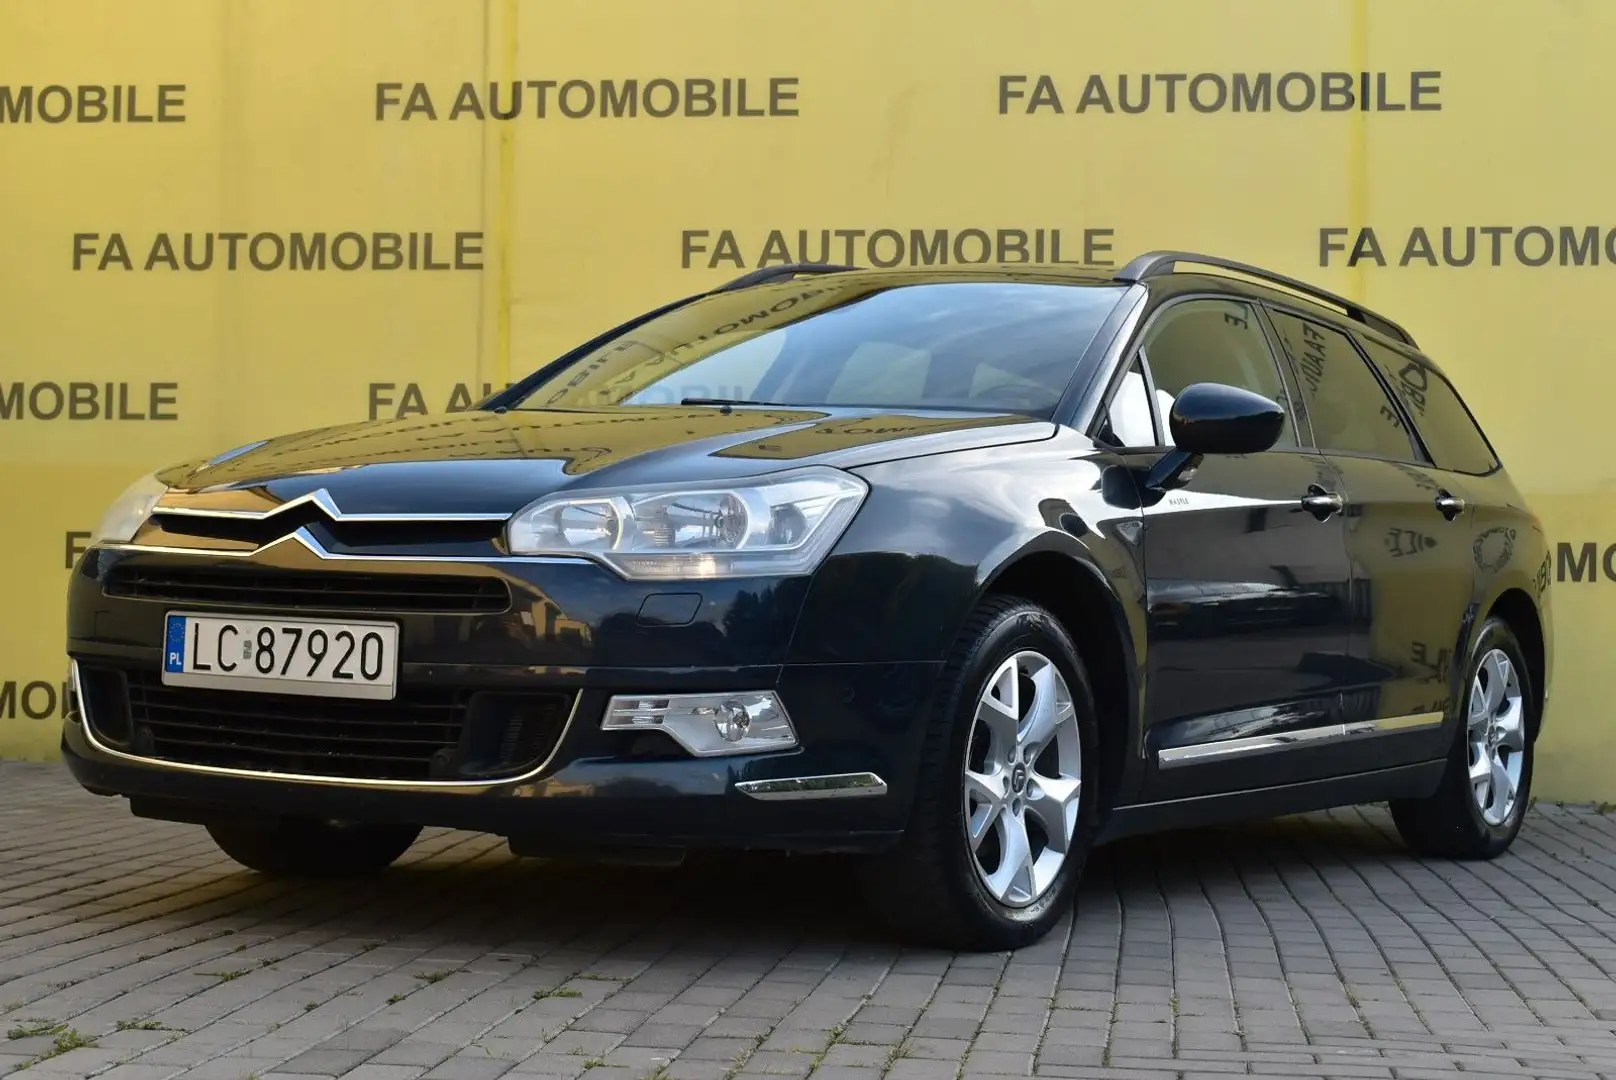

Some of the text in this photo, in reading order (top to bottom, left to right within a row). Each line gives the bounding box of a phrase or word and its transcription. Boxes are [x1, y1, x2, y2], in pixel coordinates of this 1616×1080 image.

[0, 85, 185, 123] MOBILE
[376, 78, 798, 120] FA AUTOMOBILE
[999, 71, 1441, 114] FA AUTOMOBILE
[73, 232, 484, 271] FA AUTOMOBILE
[682, 229, 1114, 268] FA AUTOMOBILE
[1320, 228, 1386, 267] FA
[369, 383, 428, 420] FA
[169, 623, 384, 680] PL LC 87920
